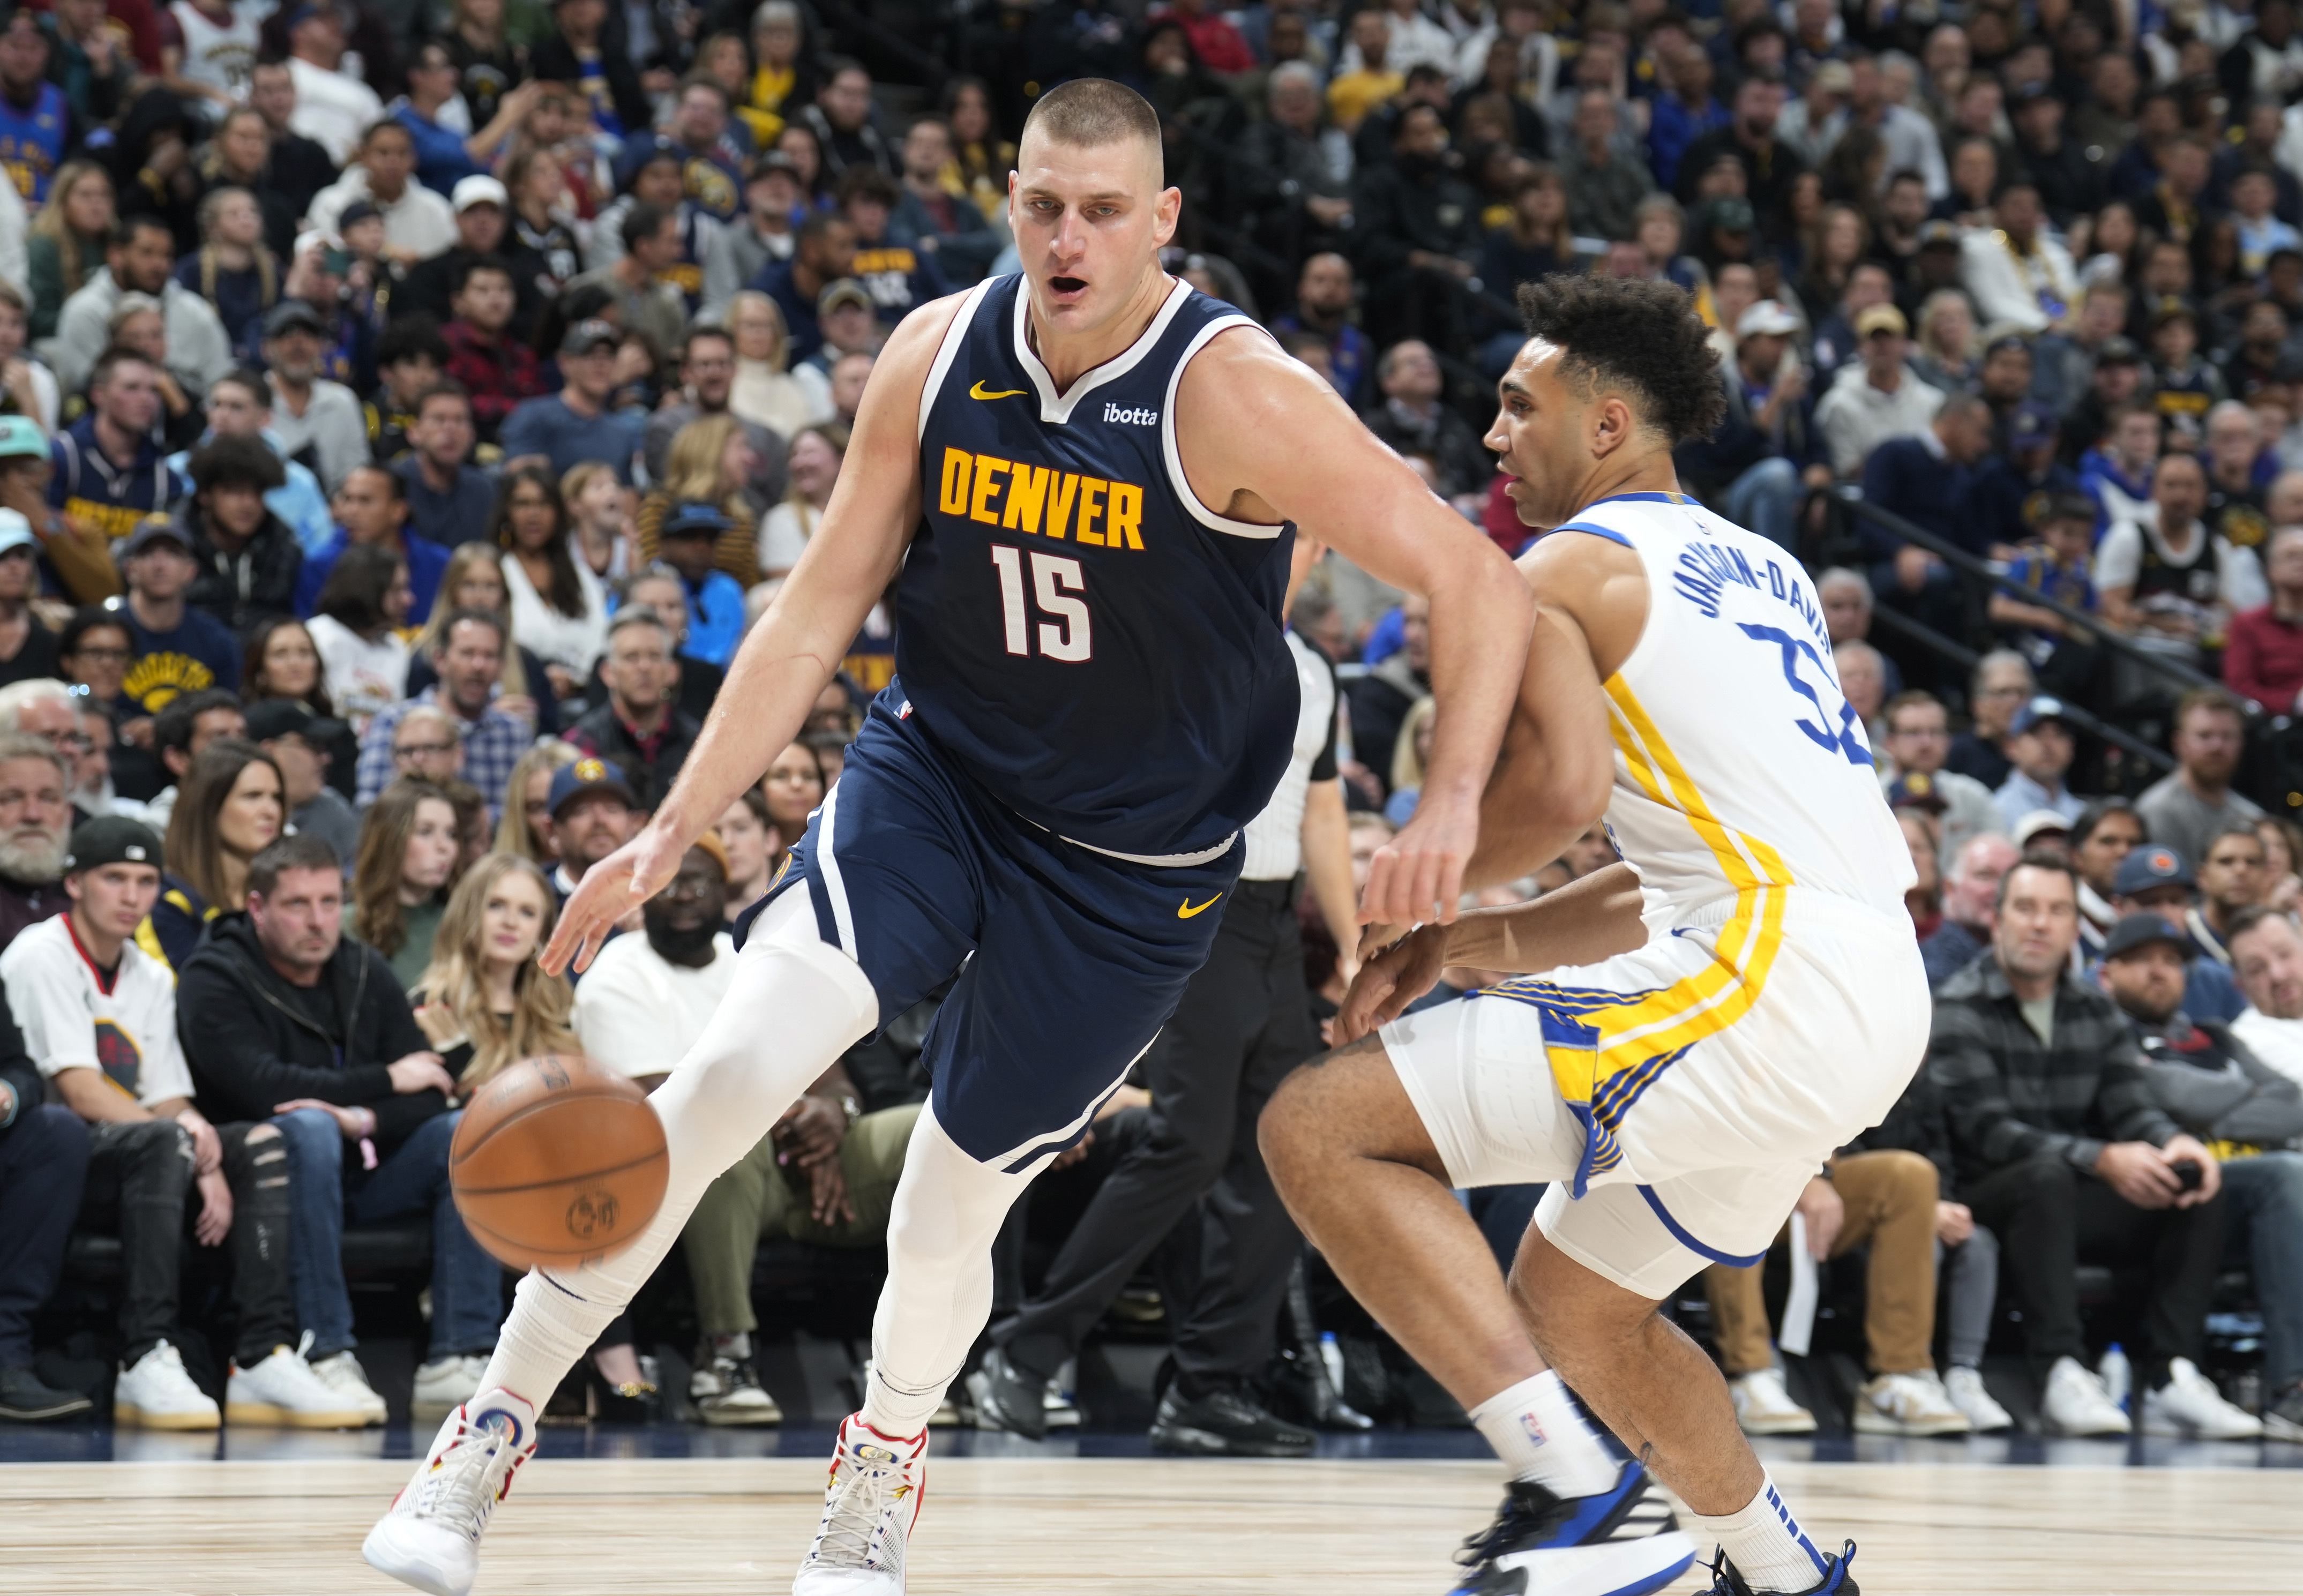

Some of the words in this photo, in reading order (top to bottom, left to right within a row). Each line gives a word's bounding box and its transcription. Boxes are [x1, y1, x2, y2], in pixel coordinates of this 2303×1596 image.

[1103, 402, 1157, 425] ibotta
[939, 445, 1147, 551] DENVER
[990, 543, 1093, 664] 15
